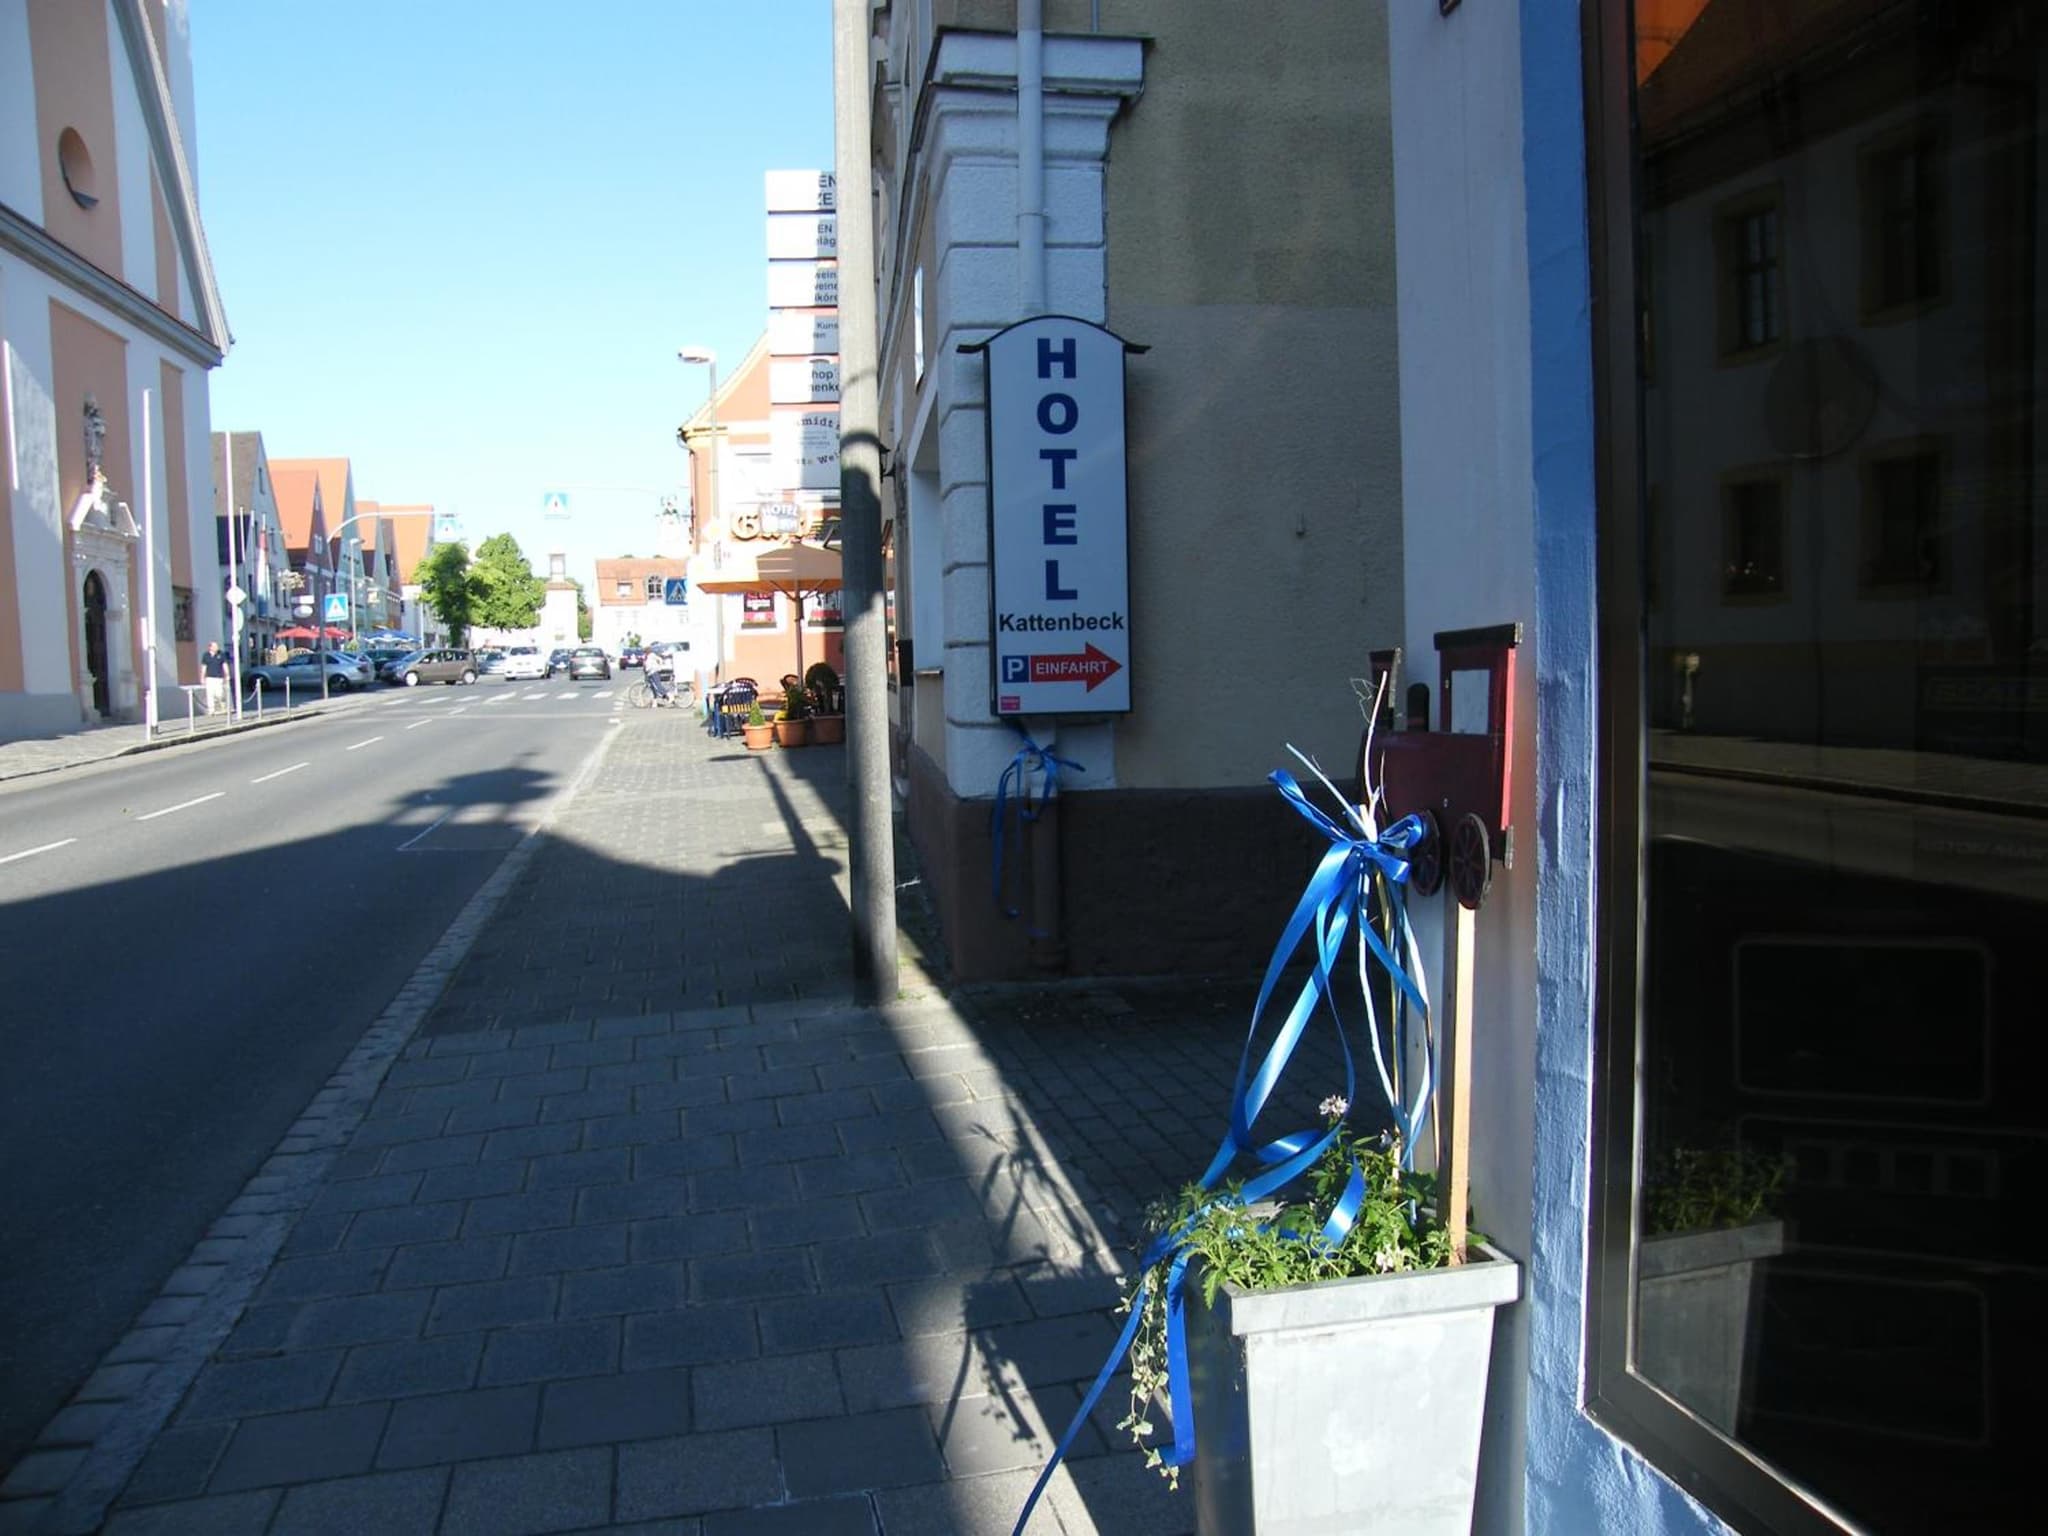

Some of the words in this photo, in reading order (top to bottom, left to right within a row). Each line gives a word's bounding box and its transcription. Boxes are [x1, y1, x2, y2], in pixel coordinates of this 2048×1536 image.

[1037, 338, 1079, 601] HOTEL
[999, 611, 1125, 632] Kattenbeck
[1006, 658, 1025, 680] P
[1035, 660, 1110, 676] EINFAHRT
